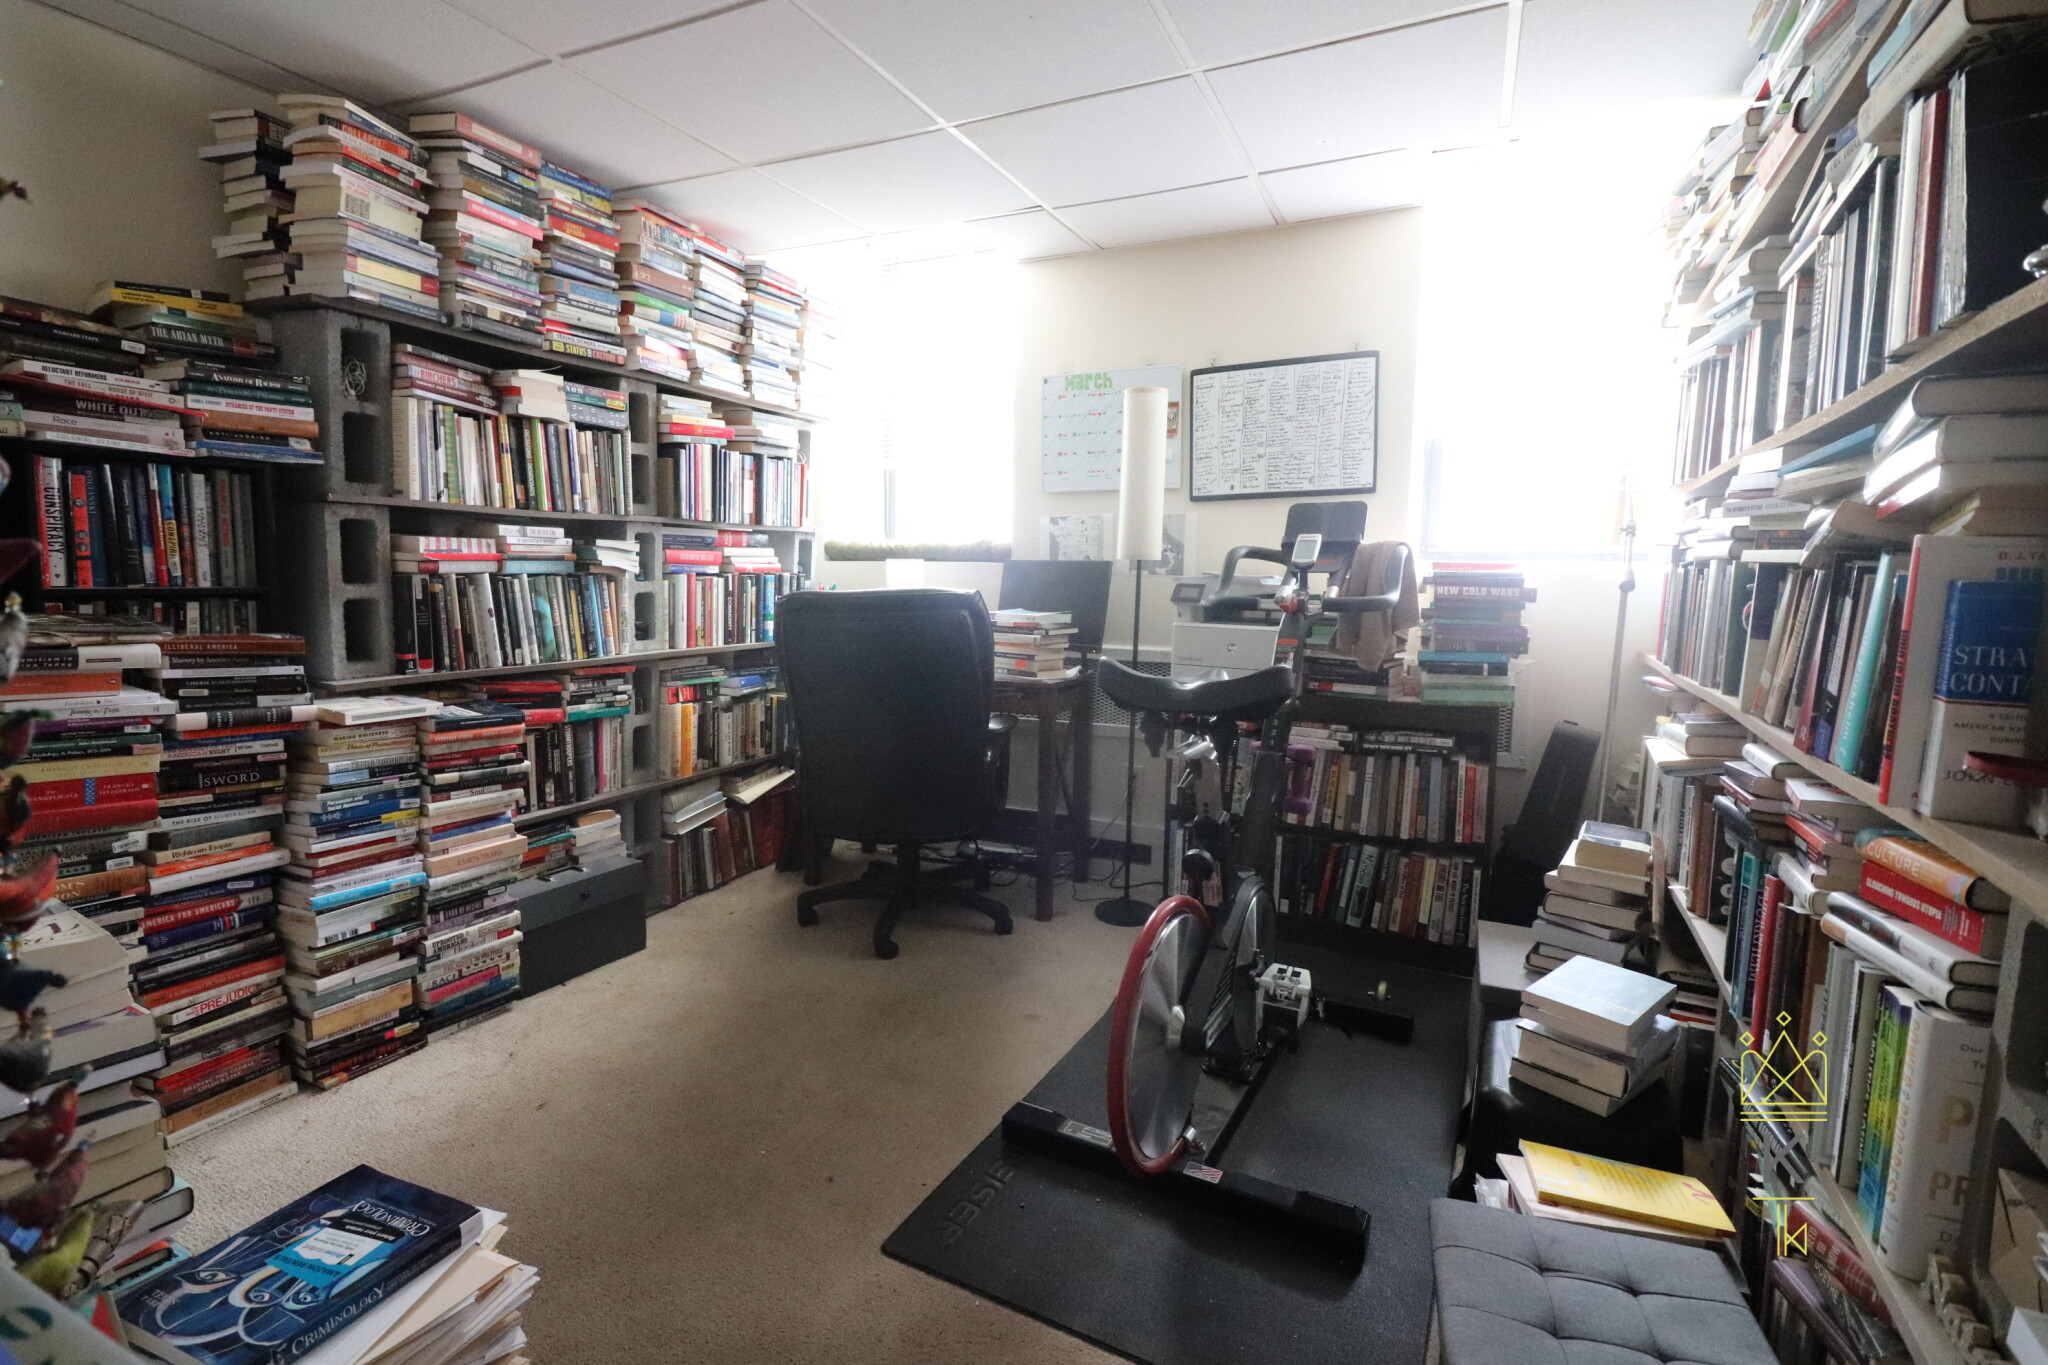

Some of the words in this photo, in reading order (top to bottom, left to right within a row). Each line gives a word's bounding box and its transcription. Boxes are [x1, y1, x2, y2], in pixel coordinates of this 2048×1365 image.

[151, 326, 169, 339] THE
[200, 333, 225, 347] MYTH
[565, 344, 588, 357] STATUS
[592, 350, 618, 364] CULTURE
[41, 365, 73, 376] RELUCTANT
[75, 370, 108, 381] REFORMERS
[212, 373, 243, 385] ANATOMY
[420, 370, 457, 387] BIRCHERS
[78, 381, 91, 389] FALL
[1064, 373, 1113, 391] March
[75, 400, 117, 414] WHITE
[119, 404, 145, 416] OUT
[53, 415, 78, 426] Race
[56, 433, 93, 444] COLONIAL
[96, 438, 123, 447] DESIRE
[44, 486, 64, 554] CONSPIRACY
[1437, 586, 1459, 595] NEW
[1463, 587, 1487, 596] COLD
[1490, 587, 1520, 597] WARS
[171, 656, 197, 664] Slavery
[357, 730, 389, 738] WHITENESS
[204, 772, 260, 787] SWORD
[469, 787, 485, 795] Soul
[58, 854, 89, 864] Dallek
[171, 846, 207, 859] Righteous
[482, 849, 503, 859] TEARS
[1867, 842, 1921, 876] CULTURE
[1357, 854, 1374, 884] NATIONS
[1866, 877, 1895, 898] SLOUCHING
[1895, 889, 1921, 910] TOWARDS
[1920, 901, 1943, 921] UTOPIA
[141, 915, 176, 928] AMERICA
[178, 911, 193, 919] FOR
[195, 899, 235, 915] AMERICANS
[248, 896, 261, 904] LEE
[432, 932, 464, 948] UPROOTED
[433, 937, 468, 954] AMERICANS
[453, 937, 486, 954] Hooked
[481, 947, 504, 961] POLITICS
[432, 971, 458, 986] RACE
[199, 985, 261, 1013] PREJUDICE
[328, 1022, 359, 1040] MOVEMENTS
[370, 1012, 392, 1025] PARTIES
[183, 1077, 214, 1093] DRAWING
[230, 1061, 256, 1075] GLOBAL
[224, 1071, 243, 1082] LINE
[351, 1200, 431, 1237] CRIMINOLOGY
[274, 1254, 315, 1271] RENTALS
[316, 1264, 342, 1277] AMAZON
[291, 1277, 388, 1357] CRIMINOLOGY
